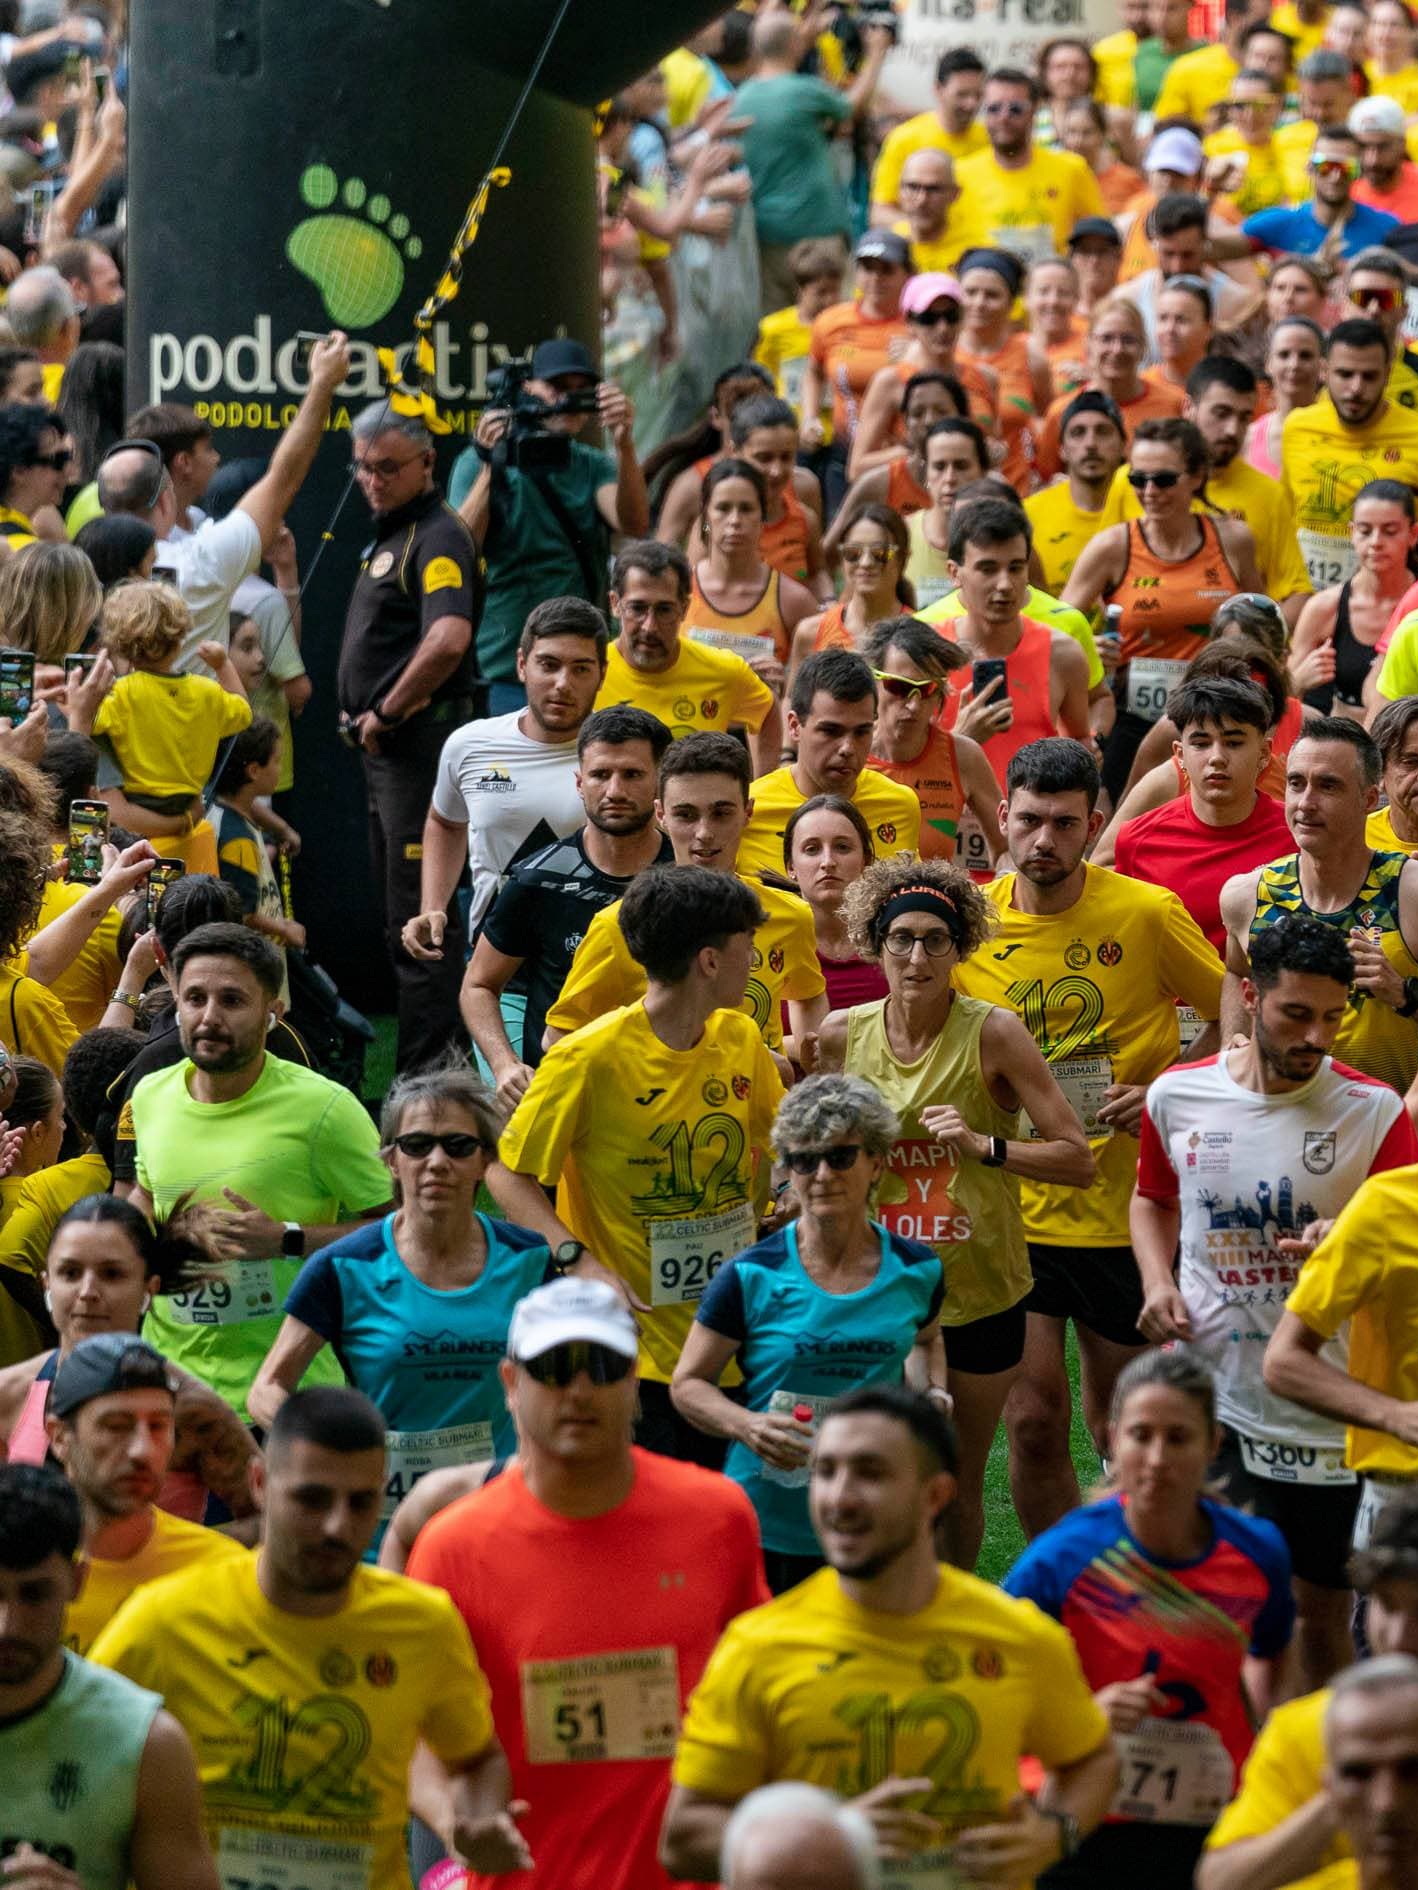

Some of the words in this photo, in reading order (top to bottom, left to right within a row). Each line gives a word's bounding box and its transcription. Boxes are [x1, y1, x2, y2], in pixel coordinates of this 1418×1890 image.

[1005, 976, 1104, 1061] 12
[649, 1112, 746, 1209] 12
[887, 1145, 956, 1168] MAPI
[915, 1178, 933, 1203] Y
[676, 1222, 712, 1236] CELTIC
[660, 1251, 726, 1289] 926
[555, 1701, 607, 1742] 51
[231, 1694, 372, 1816] 12
[1132, 1761, 1178, 1803] 71
